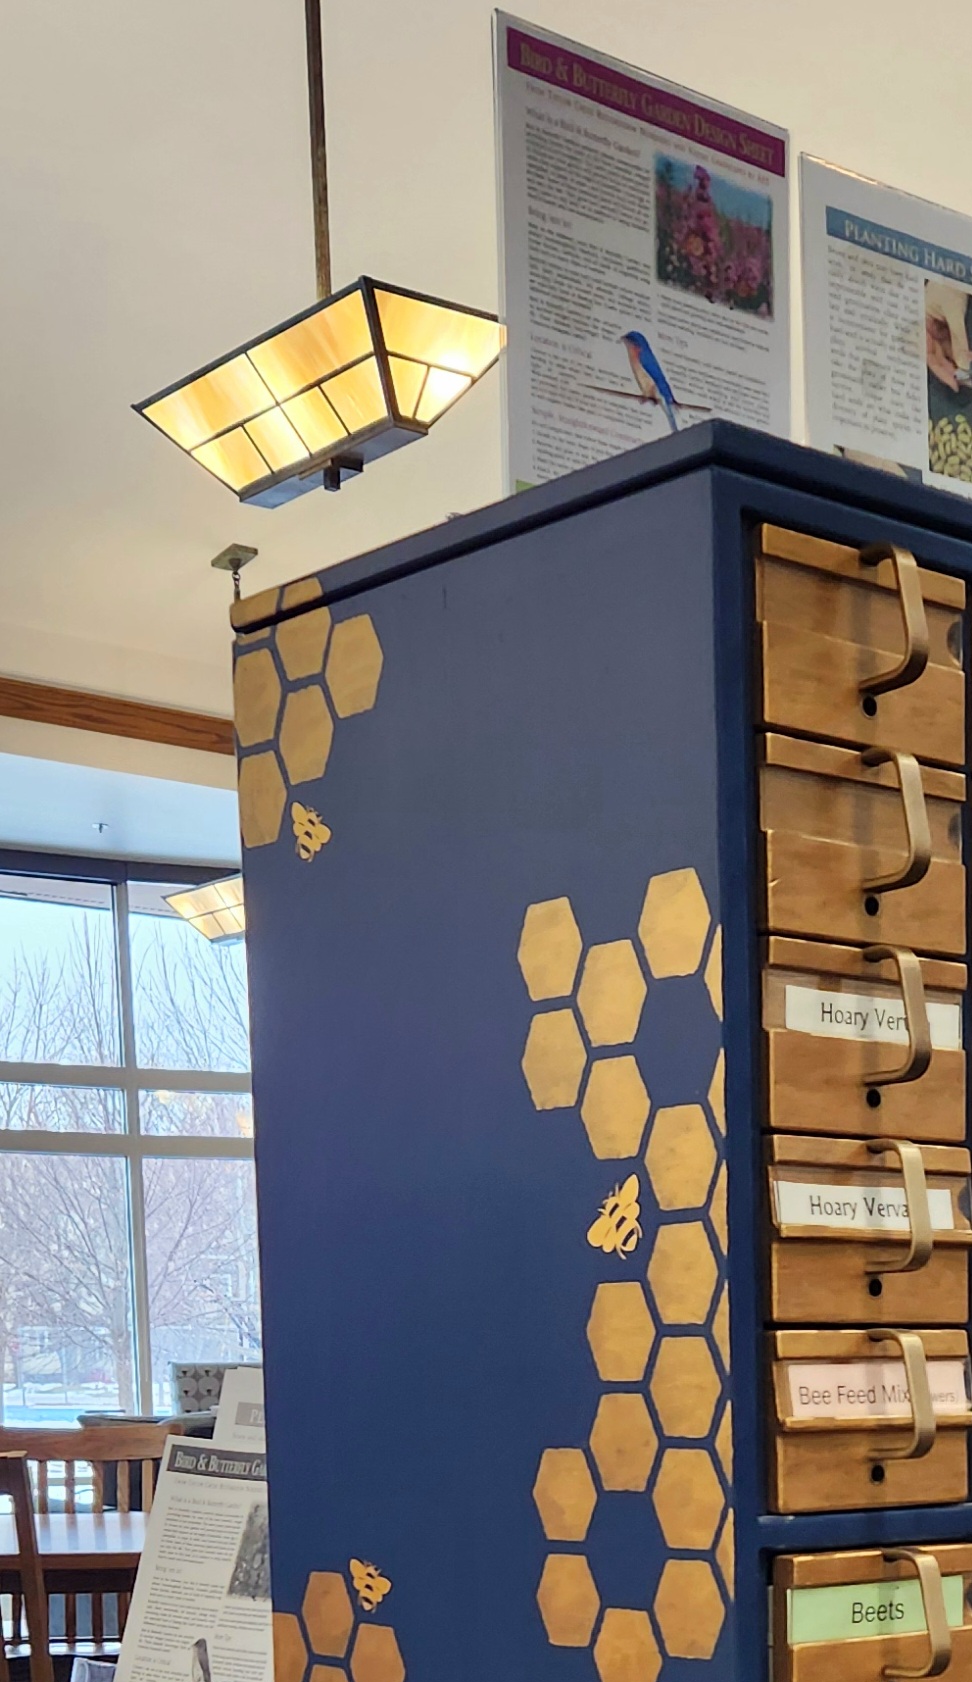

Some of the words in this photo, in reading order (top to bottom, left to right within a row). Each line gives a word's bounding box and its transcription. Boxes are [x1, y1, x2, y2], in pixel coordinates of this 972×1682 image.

[520, 42, 550, 74] BIRD
[555, 58, 568, 81] &
[573, 62, 635, 112] BUTTERFLY
[641, 91, 691, 133] GARDEN
[695, 113, 736, 149] DESIGN
[739, 132, 775, 166] SHEET
[844, 219, 919, 263] PLANTING
[924, 247, 966, 279] HARD
[821, 1002, 869, 1032] Hoary
[809, 1195, 857, 1220] Hoary
[863, 1197, 909, 1218] Verva
[799, 1386, 832, 1405] Bee
[837, 1385, 876, 1404] Feed
[882, 1385, 910, 1403] Mix
[197, 1453, 208, 1471] &
[852, 1601, 905, 1625] Beets
